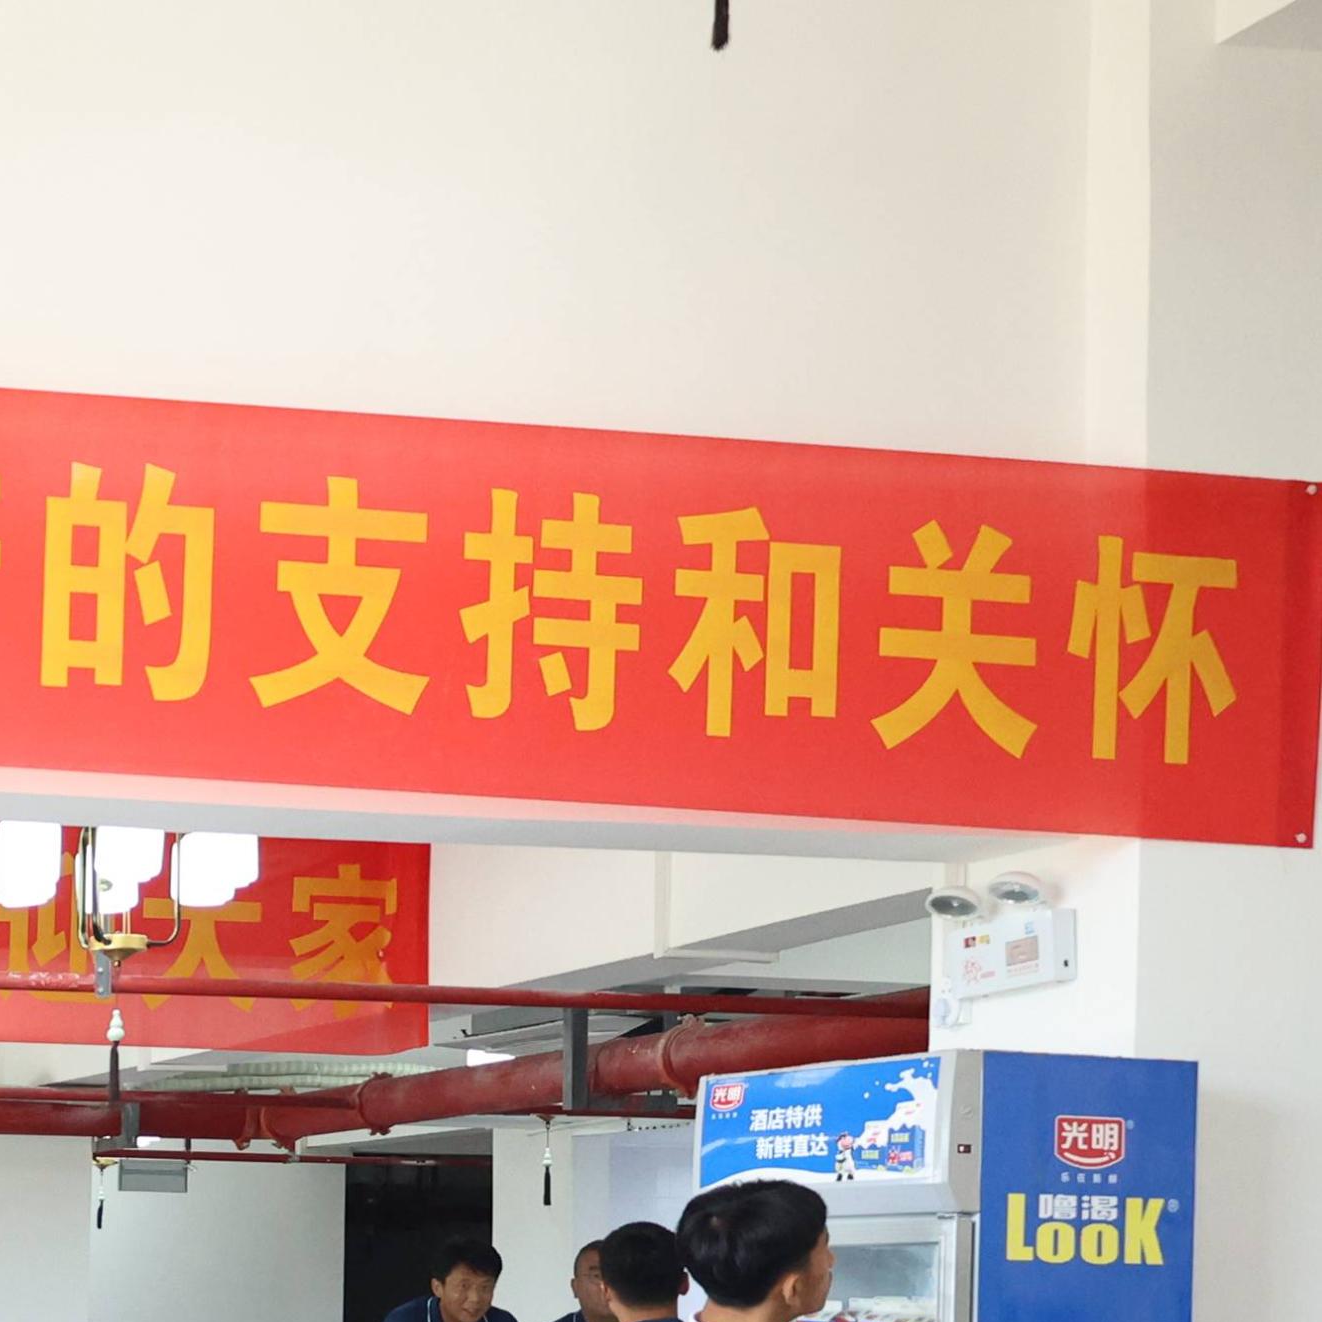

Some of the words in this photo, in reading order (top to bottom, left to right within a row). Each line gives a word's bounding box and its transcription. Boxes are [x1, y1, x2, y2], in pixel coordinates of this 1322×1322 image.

[713, 1086, 742, 1103] 光明
[749, 1103, 823, 1131] 酒店特供
[755, 1133, 829, 1160] 新鲜直达
[1060, 1121, 1120, 1150] 光明
